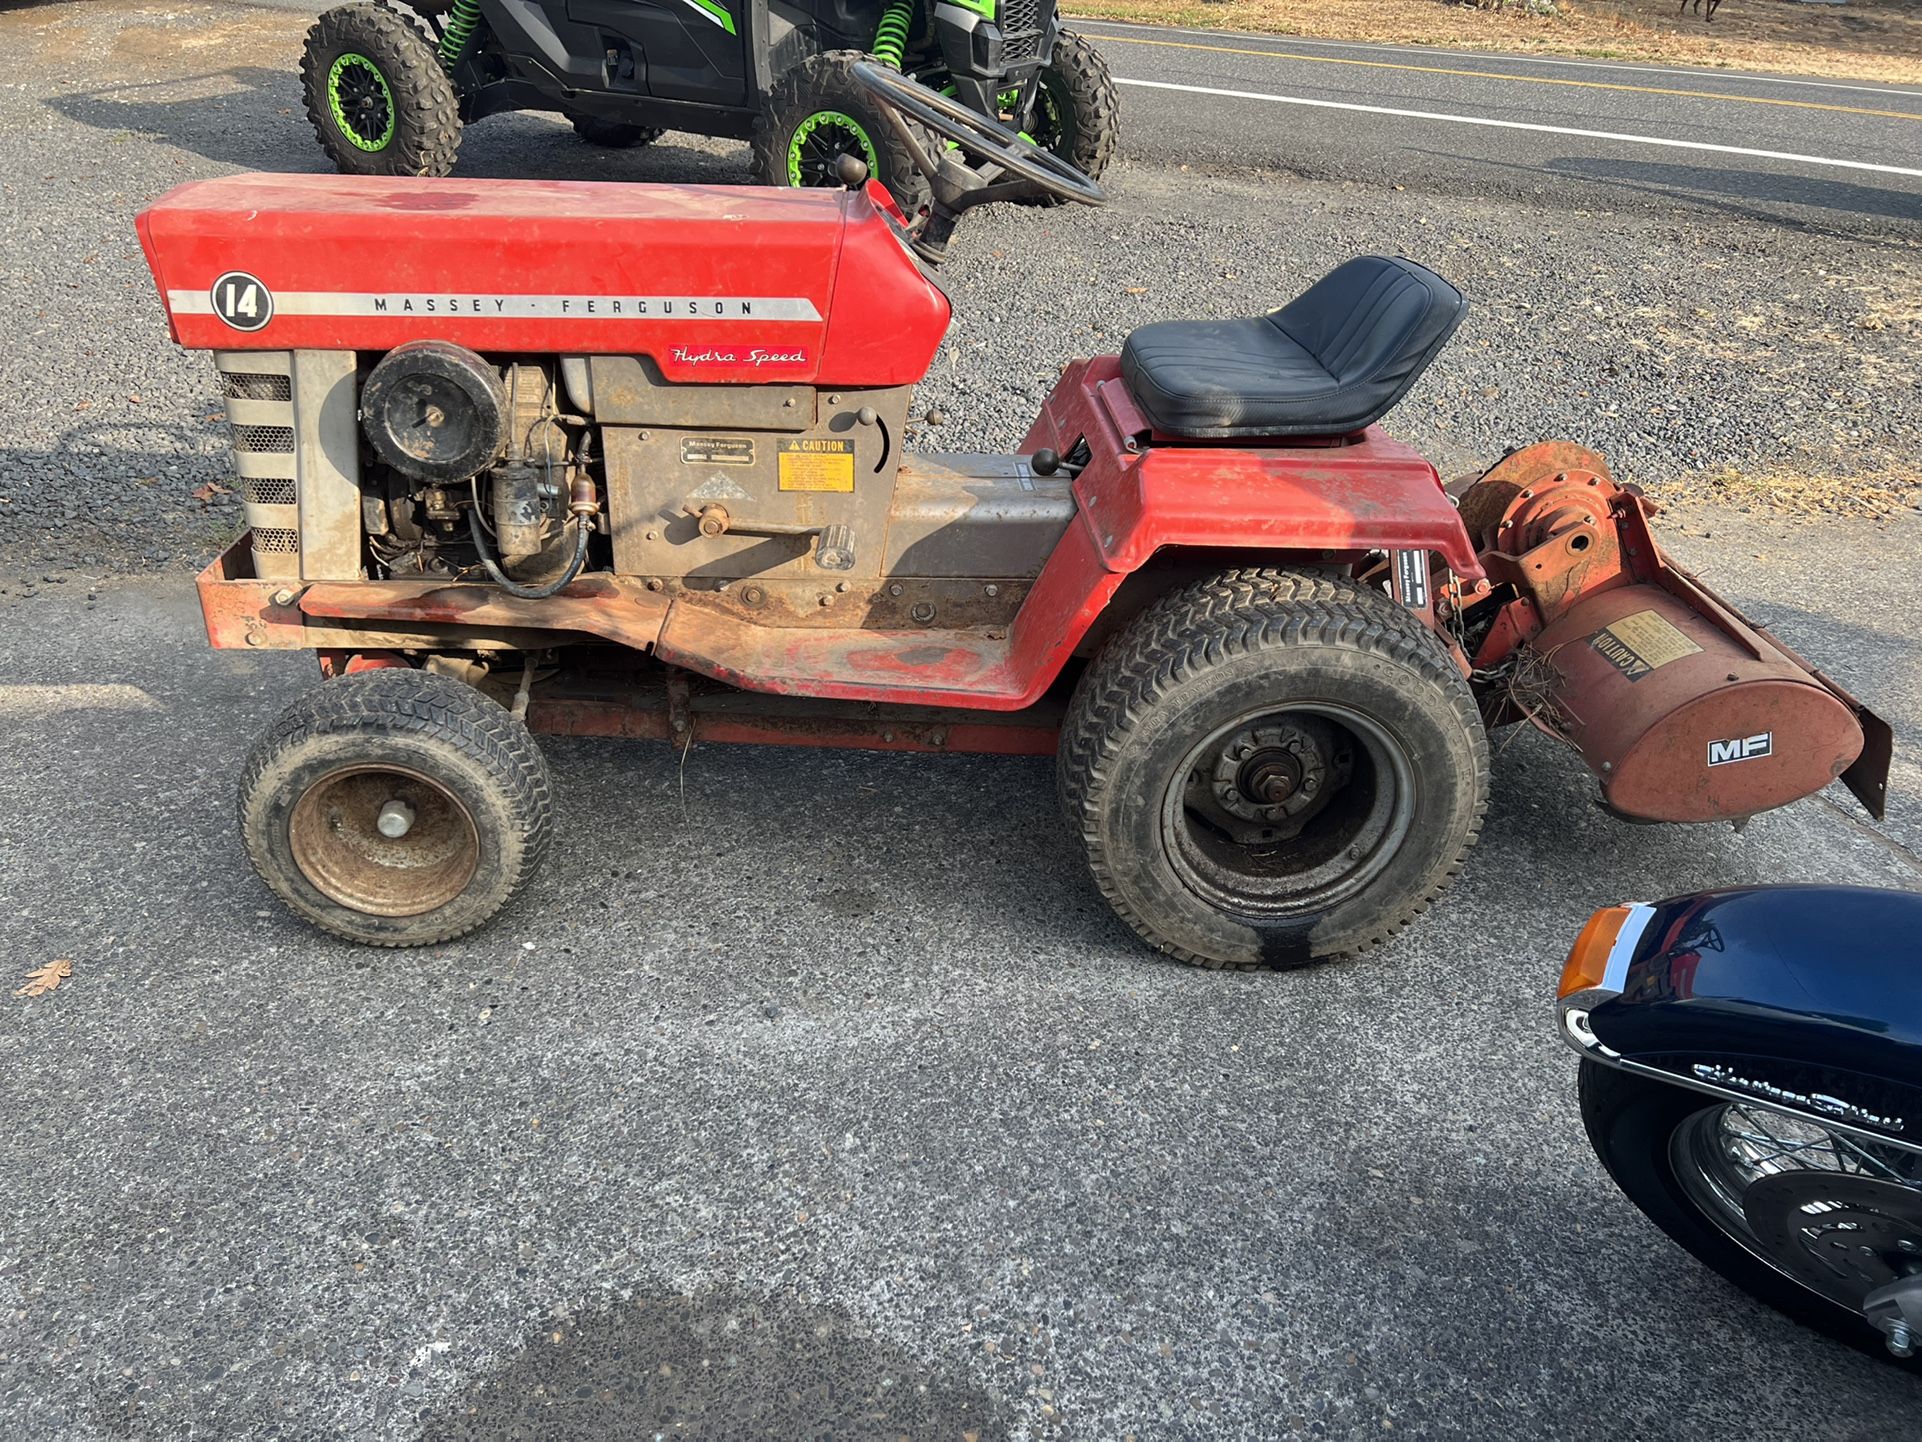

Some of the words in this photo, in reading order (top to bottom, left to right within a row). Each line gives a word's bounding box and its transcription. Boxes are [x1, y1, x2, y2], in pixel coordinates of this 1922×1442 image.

[226, 283, 258, 318] 14
[672, 346, 737, 367] Hydra
[745, 348, 807, 367] Speed
[802, 440, 844, 452] CAUTION
[1591, 632, 1635, 668] CAUTION
[1710, 733, 1769, 763] MF
